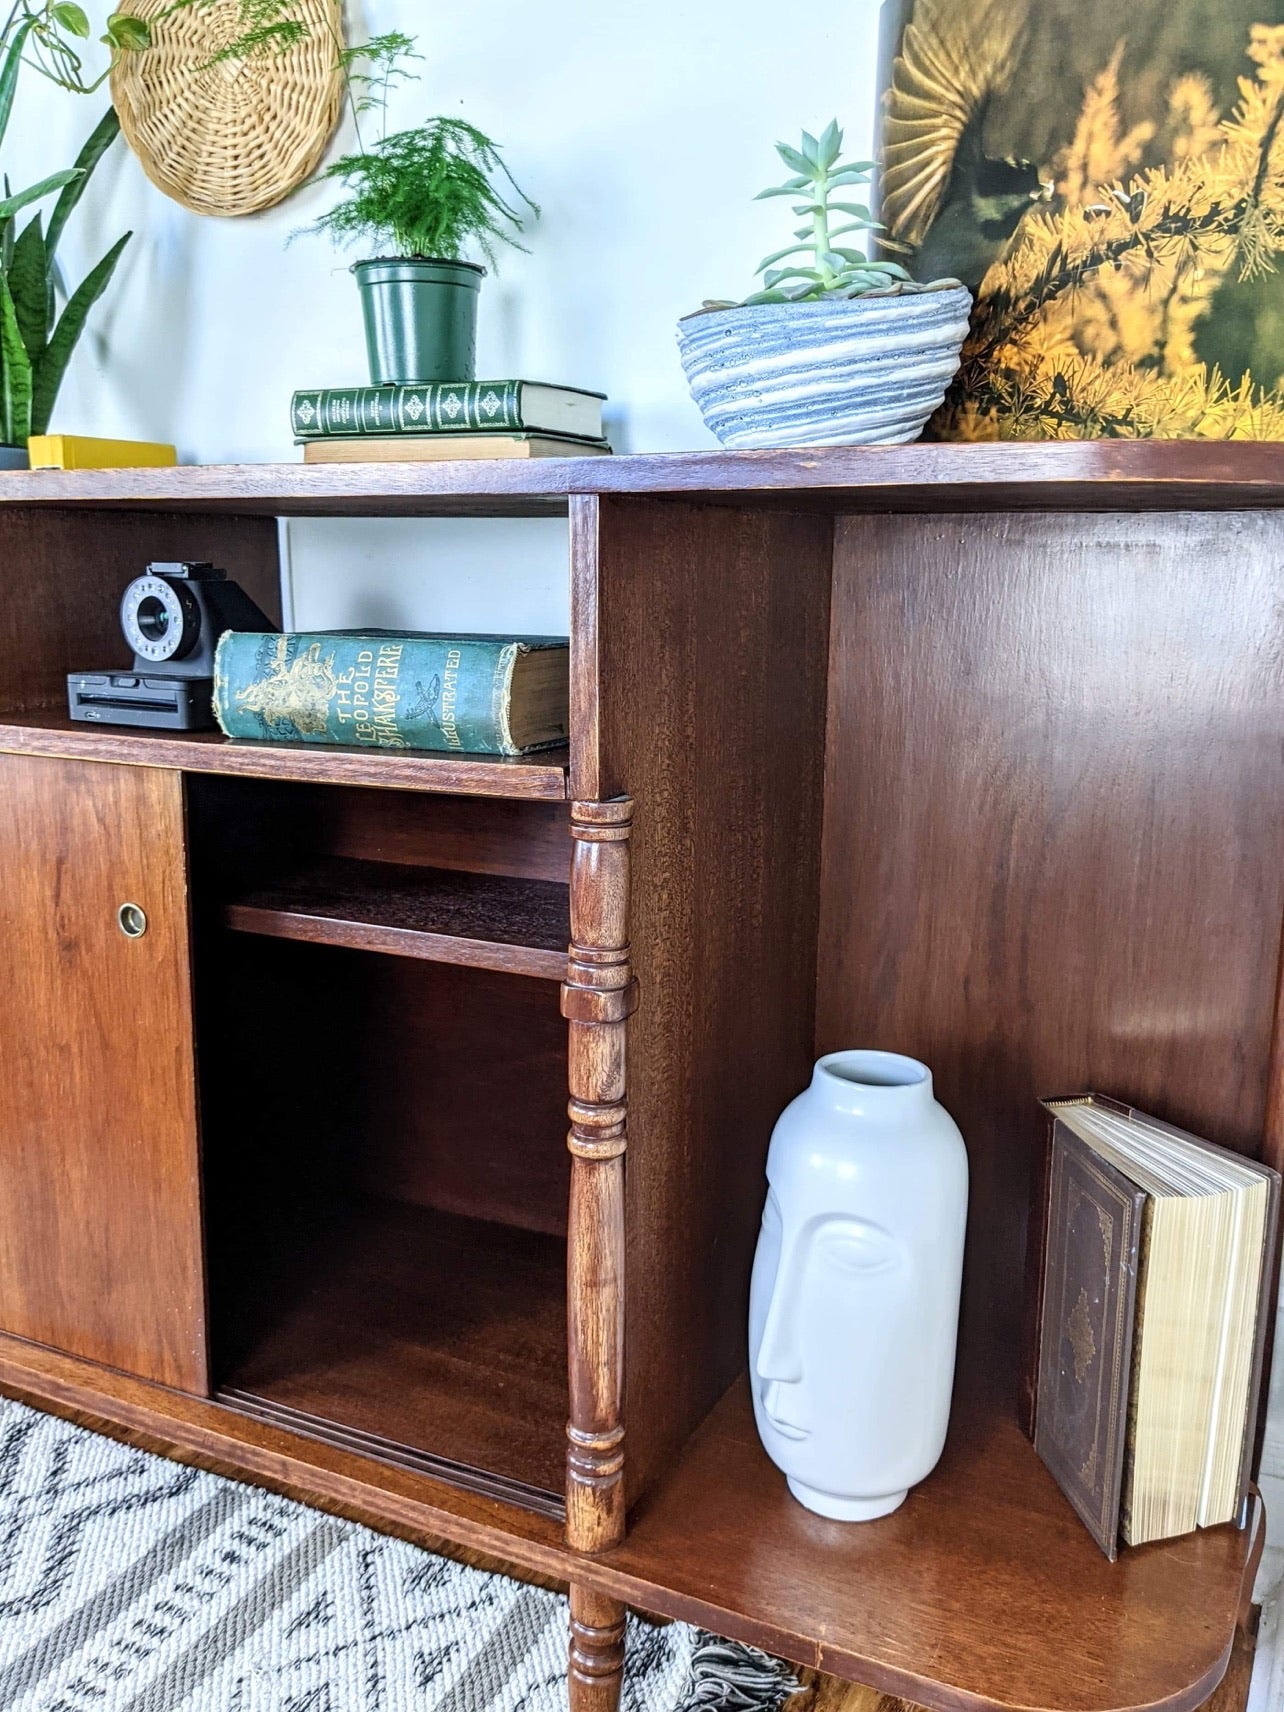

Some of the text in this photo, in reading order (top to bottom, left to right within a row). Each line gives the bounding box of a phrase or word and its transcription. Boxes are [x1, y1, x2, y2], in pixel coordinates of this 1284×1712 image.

[337, 667, 355, 724] THE
[353, 651, 376, 741] LEOPOLD
[372, 644, 410, 748] SHAKSPERE
[440, 650, 464, 752] ILLUSTRATED
